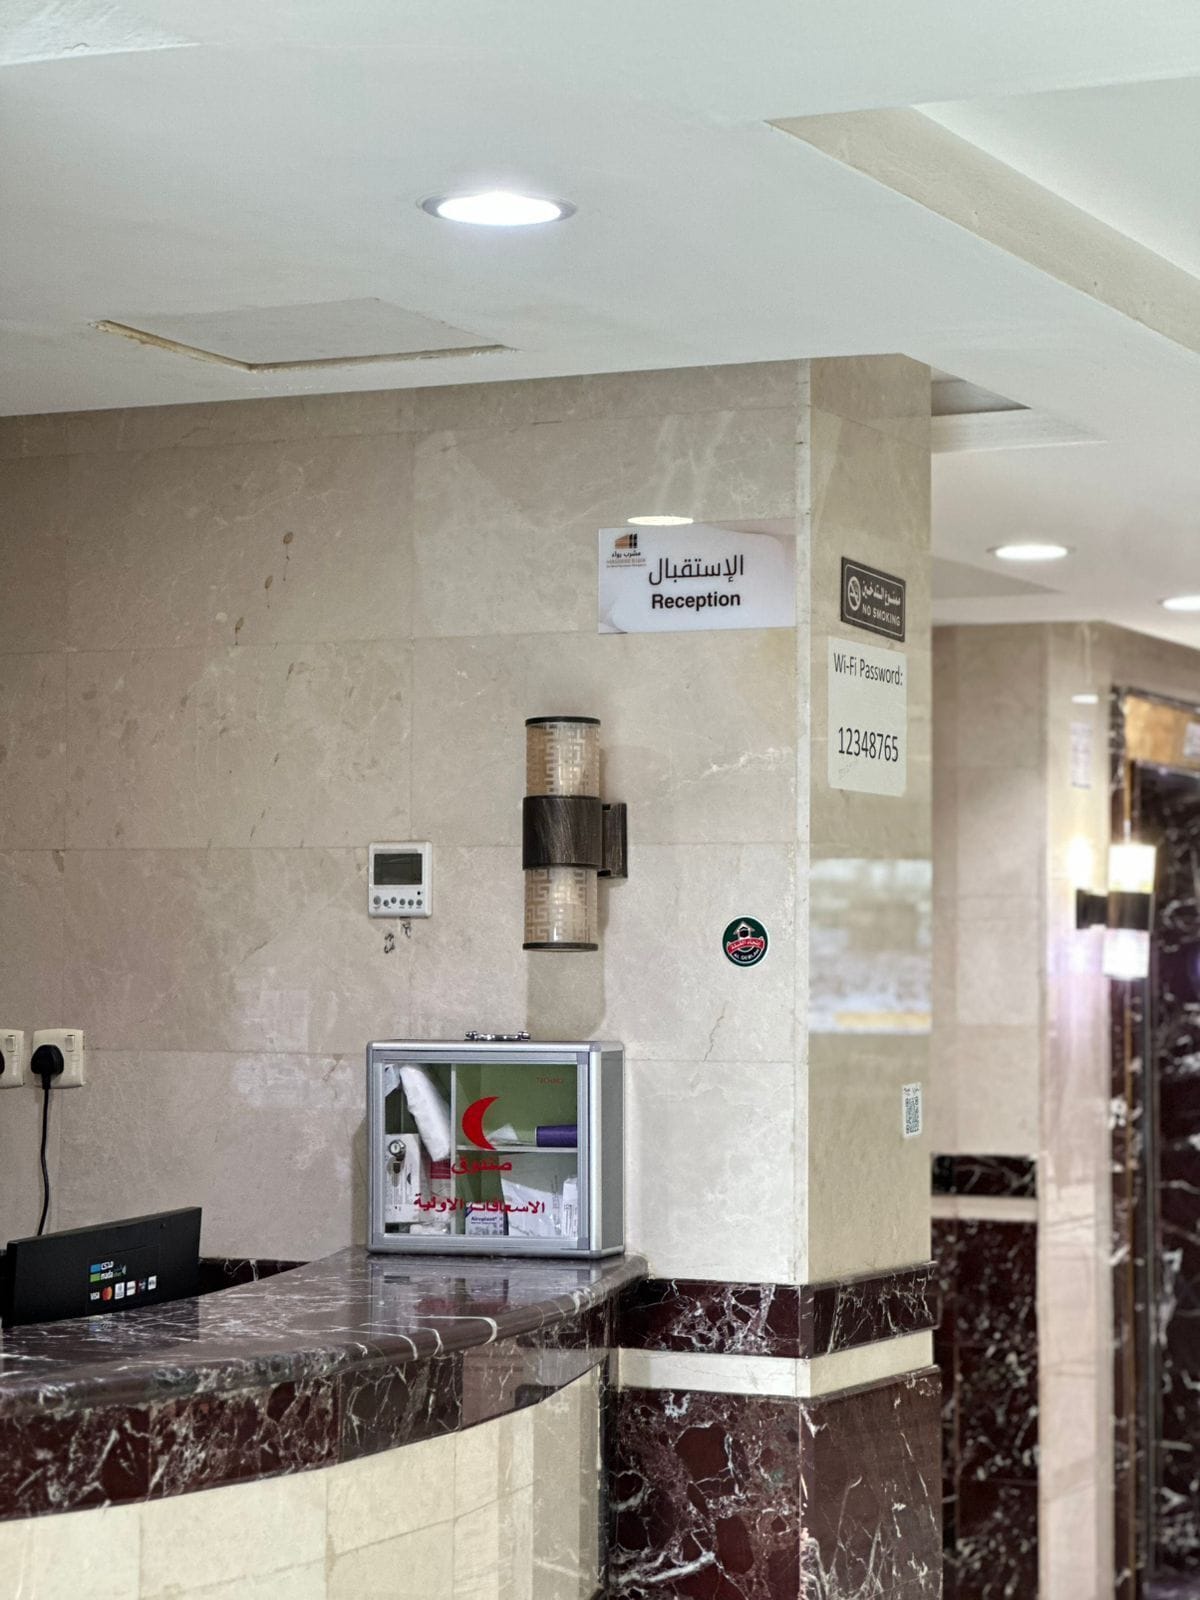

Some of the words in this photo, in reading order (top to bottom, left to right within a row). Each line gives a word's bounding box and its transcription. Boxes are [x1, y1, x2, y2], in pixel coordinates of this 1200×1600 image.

[649, 554, 743, 585] الإستقبال
[862, 580, 885, 600] التدخين
[884, 590, 901, 606] ممنوع
[652, 591, 740, 611] Reception
[862, 603, 871, 616] NO
[873, 608, 900, 626] SMOKING
[833, 652, 857, 676] Wi-Fi
[860, 659, 903, 686] Password:
[838, 727, 899, 762] 12348765
[451, 1155, 512, 1174] صندوق
[413, 1193, 463, 1212] الاولية
[469, 1199, 546, 1214] الاسعافات
